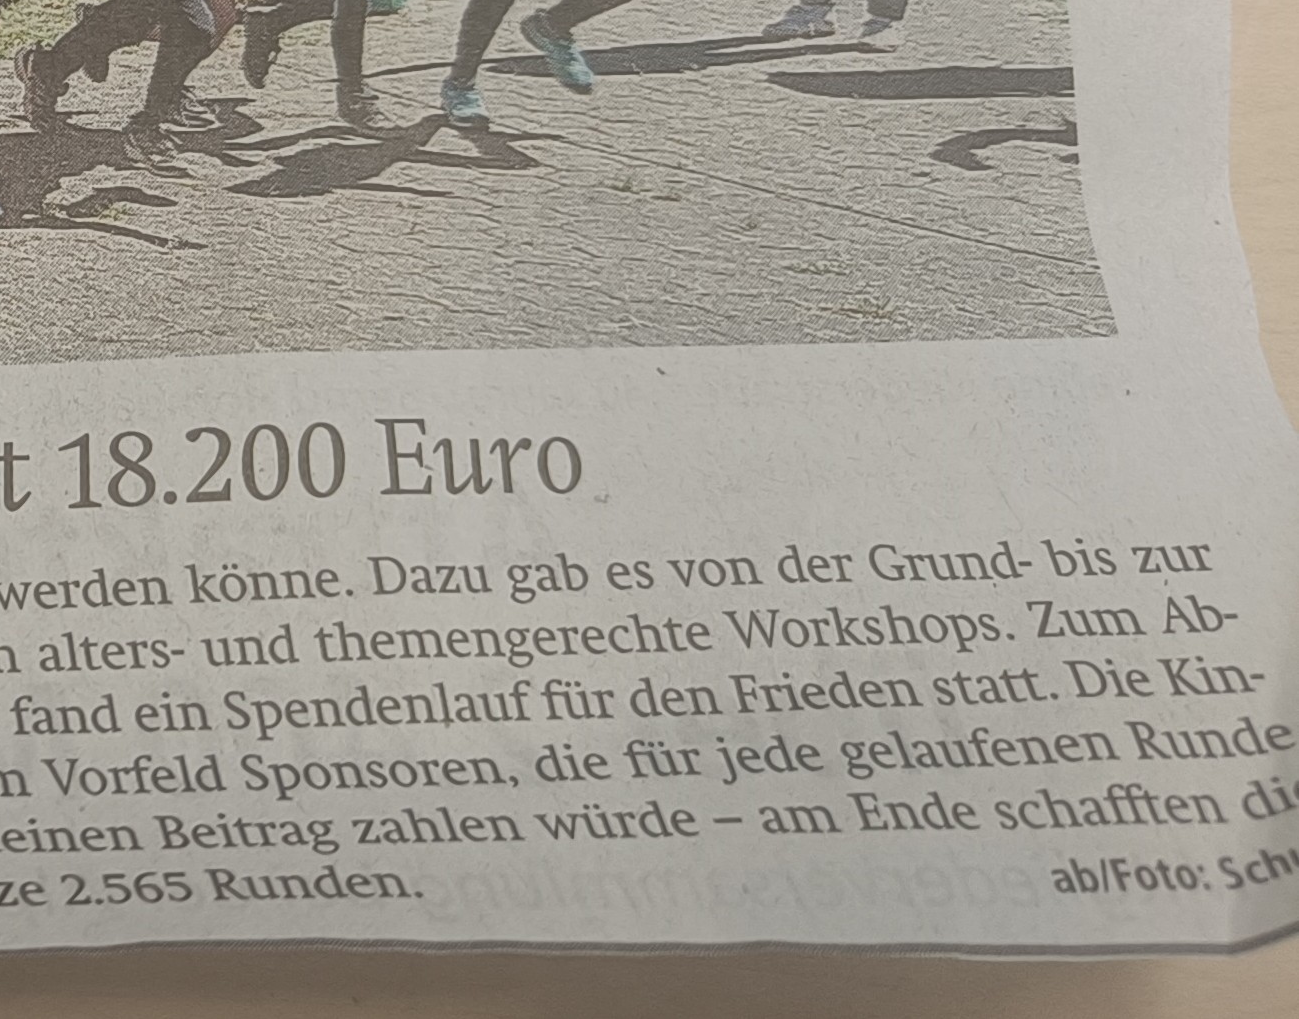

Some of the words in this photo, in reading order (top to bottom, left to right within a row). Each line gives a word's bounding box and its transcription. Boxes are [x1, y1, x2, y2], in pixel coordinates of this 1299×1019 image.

[59, 422, 345, 508] 18.200
[377, 417, 582, 495] Euro
[185, 564, 354, 603] könne.
[368, 557, 492, 595] Dazu
[508, 553, 588, 604] gab
[607, 561, 654, 590] es
[668, 558, 763, 587] von
[778, 545, 852, 583] der
[869, 541, 1032, 581] Grund-
[1041, 538, 1117, 577] bis
[1132, 545, 1212, 573] zur
[39, 632, 184, 672] alters-
[201, 624, 299, 666] und
[314, 614, 712, 668] themengerechte
[723, 605, 1016, 653] Workshops.
[1026, 601, 1146, 637] Zum
[1164, 595, 1238, 633] Ab-
[10, 694, 121, 735] fand
[135, 692, 212, 732] ein
[224, 680, 531, 741] Spendenlauf
[541, 679, 614, 720] für
[630, 678, 723, 718] den
[730, 671, 923, 713] Frieden
[933, 669, 1058, 706] statt.
[1064, 659, 1153, 697] Die
[1158, 656, 1264, 695] Kin-
[42, 755, 226, 796] Vorfeld
[241, 754, 519, 800] Sponsoren,
[535, 744, 611, 782] die
[624, 740, 701, 778] für
[718, 735, 824, 785] jede
[841, 728, 1119, 779] gelaufenen
[1126, 717, 1295, 759] Runde
[154, 813, 339, 855] Beitrag
[352, 807, 524, 844] zahlen
[535, 801, 698, 839] würde
[759, 806, 841, 833] am
[848, 792, 979, 830] Ende
[995, 784, 1226, 830] schafften
[61, 872, 192, 905] 2.565
[205, 865, 423, 900] Runden.
[1052, 859, 1210, 893] ab/Foto:
